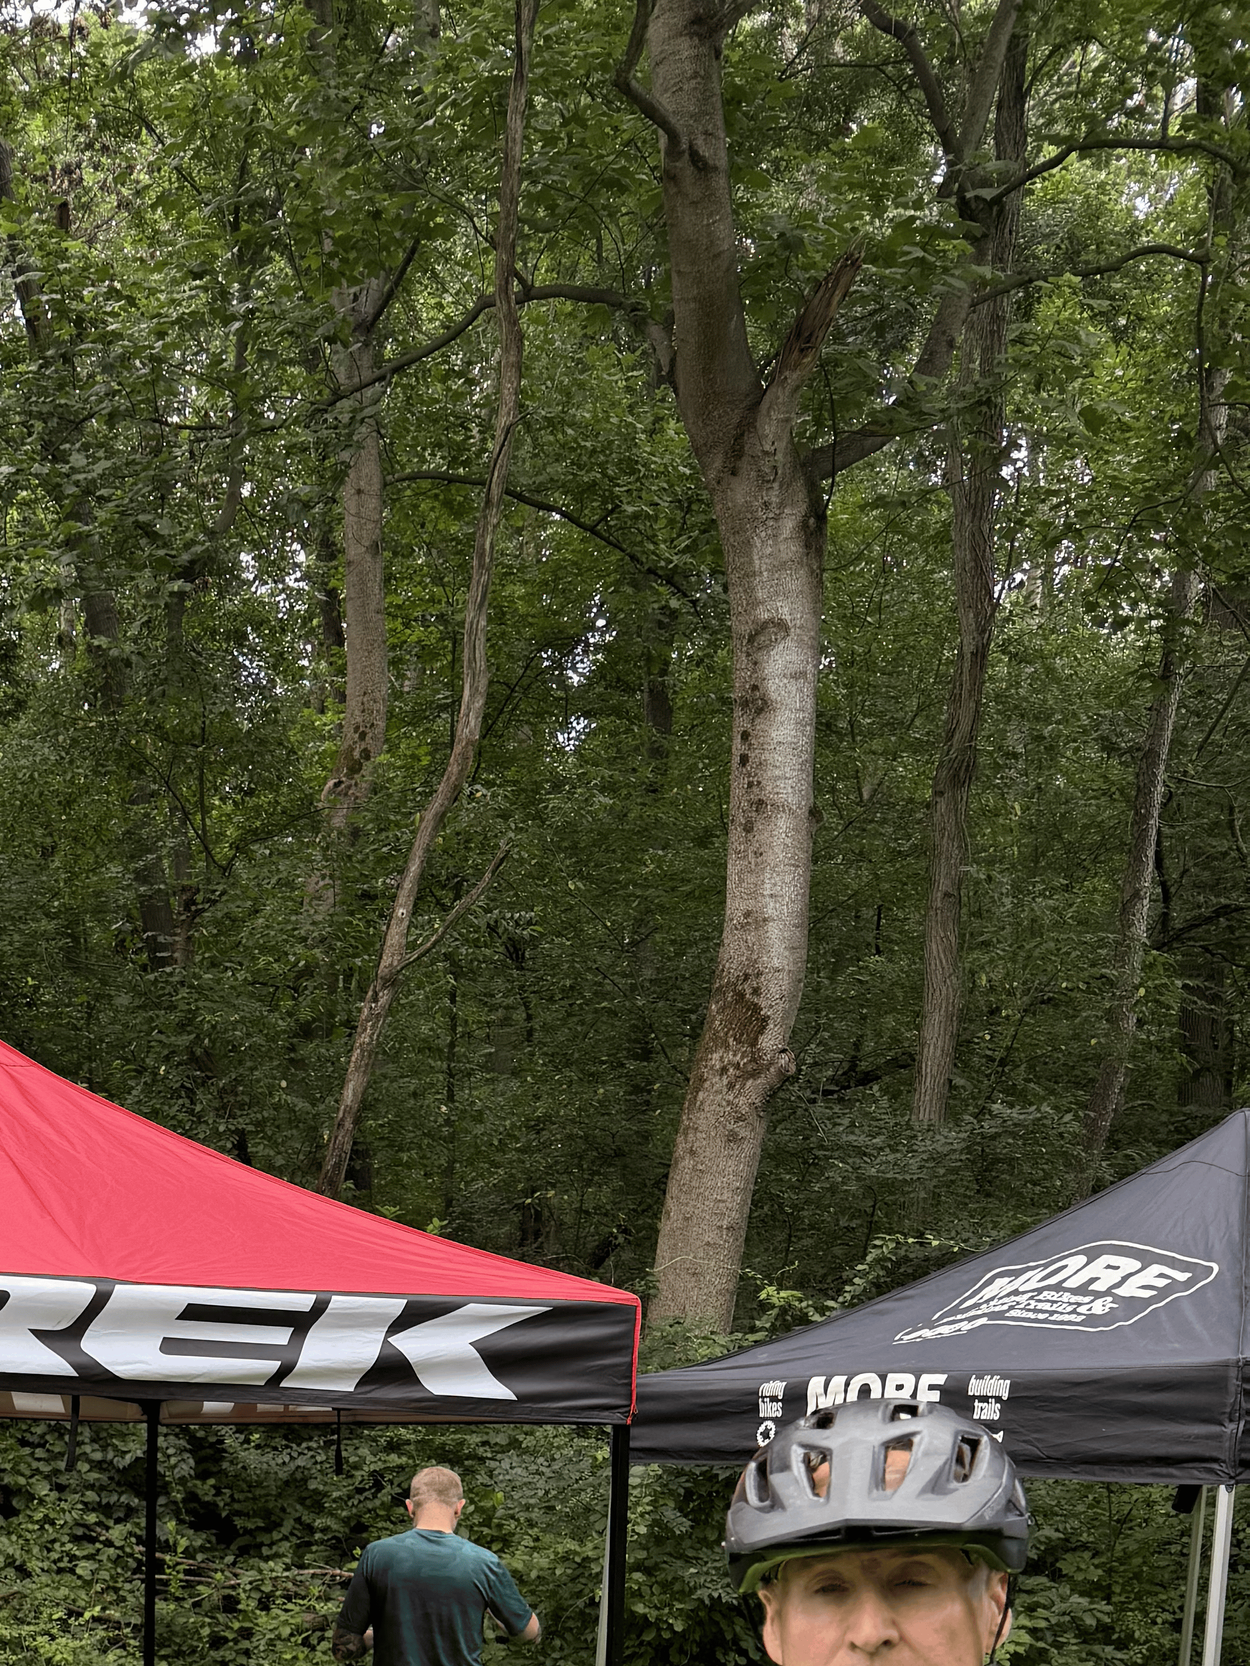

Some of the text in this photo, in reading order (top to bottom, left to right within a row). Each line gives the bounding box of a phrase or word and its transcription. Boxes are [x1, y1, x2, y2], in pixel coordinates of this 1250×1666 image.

[960, 1255, 1193, 1309] MORE
[759, 1380, 787, 1399] riding
[968, 1375, 1011, 1400] building
[759, 1397, 783, 1418] bikes
[973, 1398, 1002, 1420] trails
